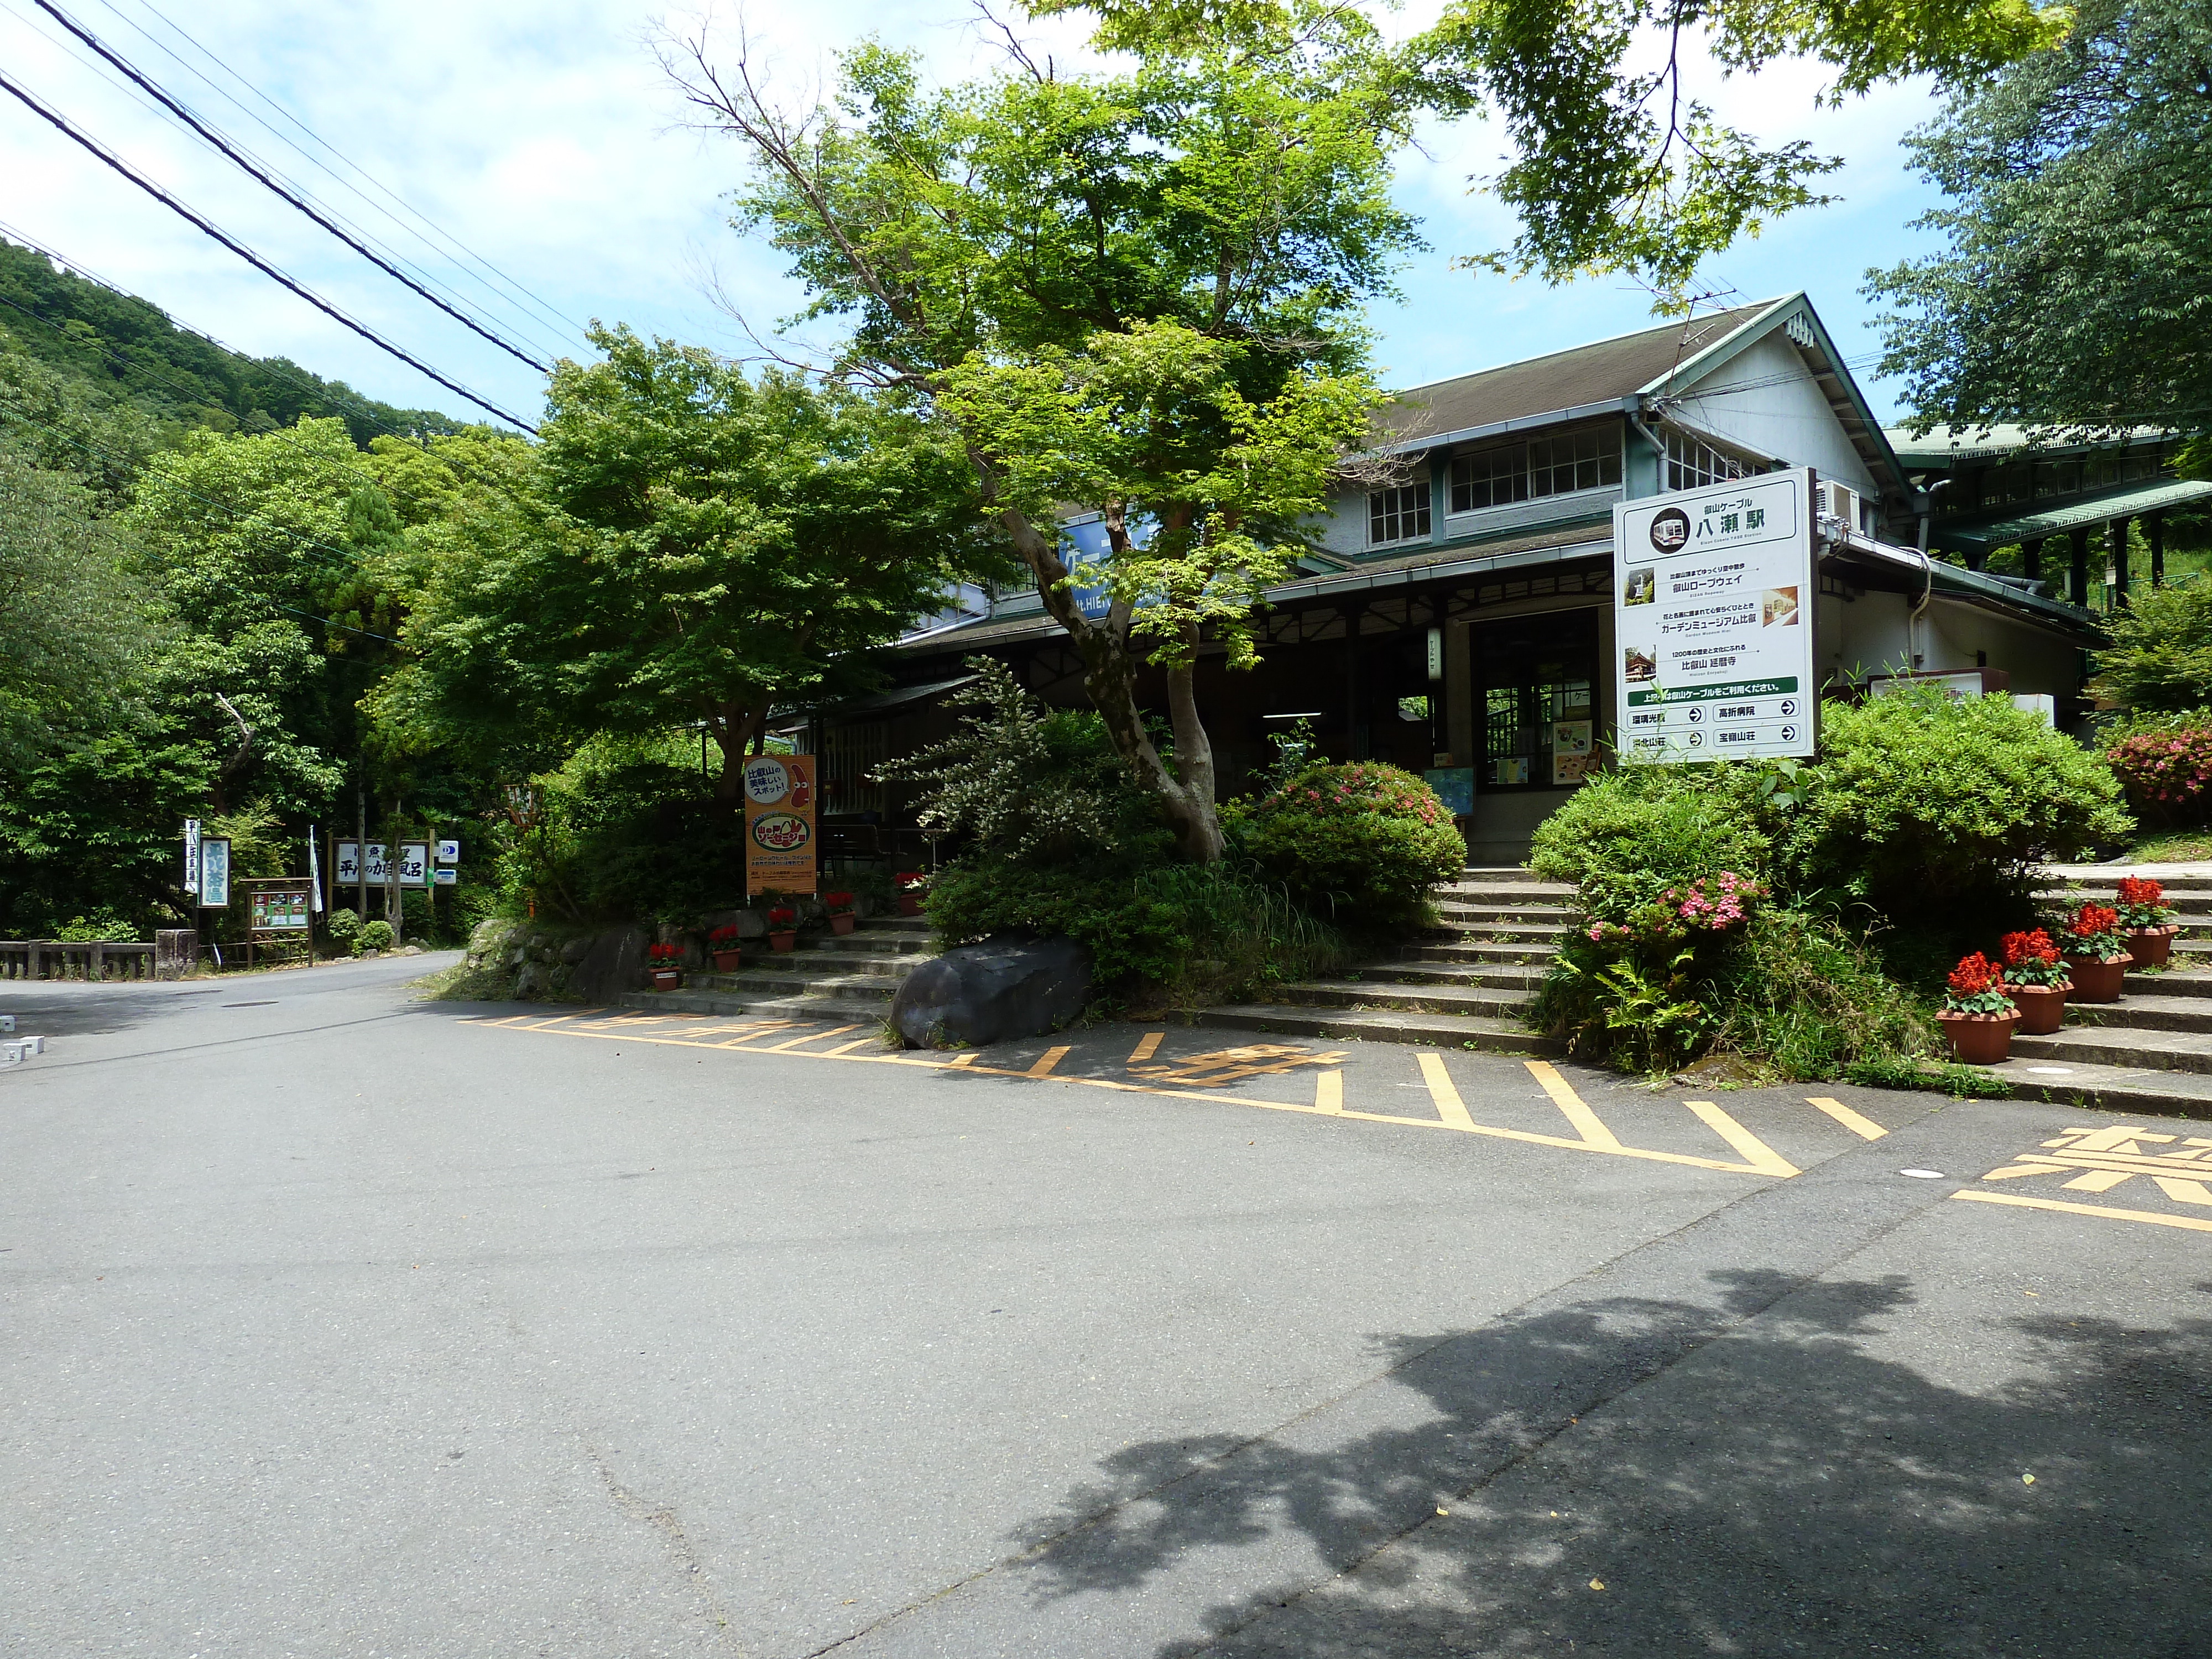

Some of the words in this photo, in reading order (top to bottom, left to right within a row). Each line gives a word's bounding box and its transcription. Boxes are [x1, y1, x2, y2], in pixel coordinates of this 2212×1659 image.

[1704, 498, 1752, 515] 叡山ケーブル
[1695, 509, 1765, 538] 八瀬駅
[1673, 575, 1743, 593] 叡山ロープウェイ
[1662, 613, 1756, 634] ガーデンミュージアム比叡
[1672, 644, 1746, 658] 1200年の歴史と文化にふれる
[1682, 659, 1708, 671] 比叡山
[1710, 656, 1736, 667] 延暦寺
[1719, 706, 1755, 718] 高折病院
[748, 766, 781, 779] 比叡山の
[749, 776, 781, 789] 美味しい
